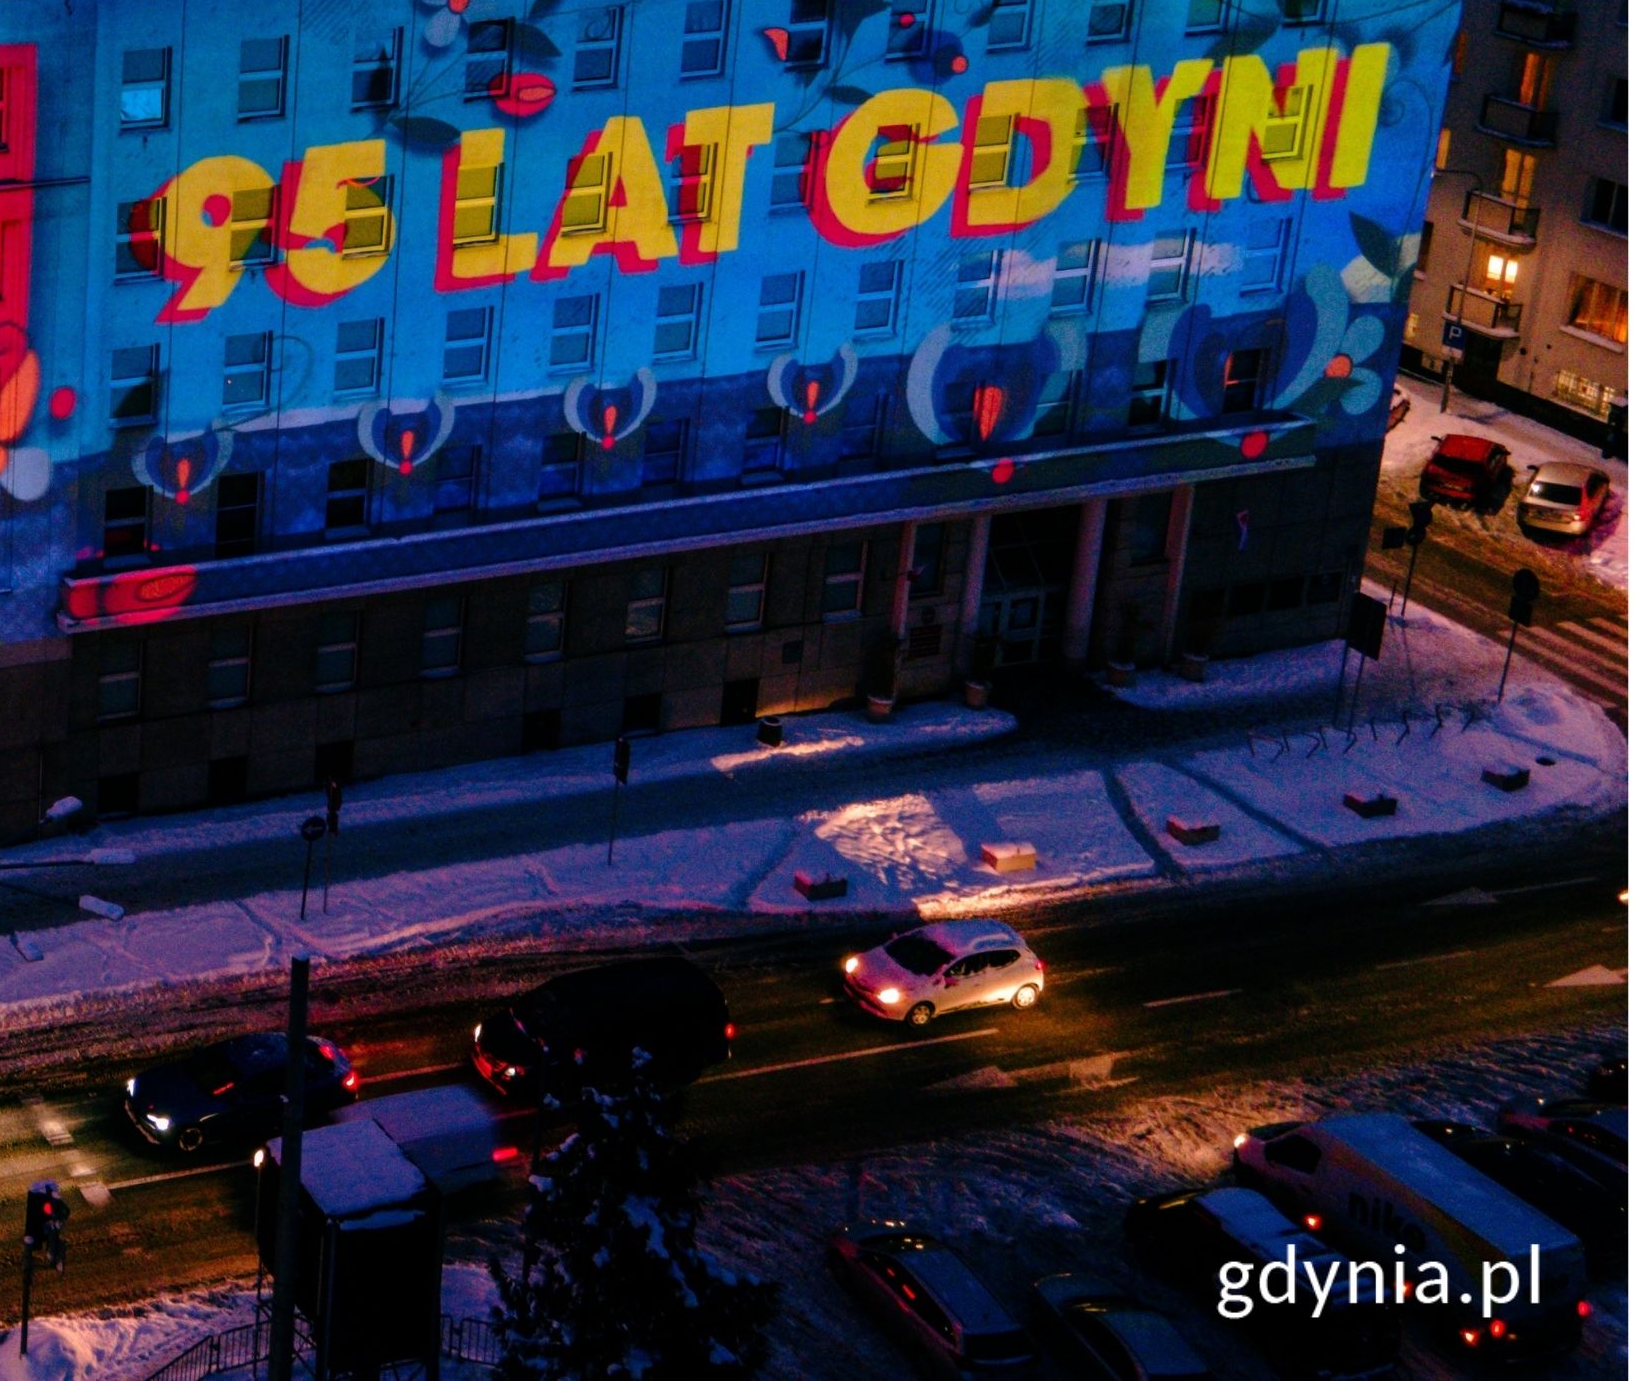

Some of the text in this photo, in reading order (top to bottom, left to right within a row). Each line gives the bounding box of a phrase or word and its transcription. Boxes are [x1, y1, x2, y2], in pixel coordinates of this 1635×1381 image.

[153, 42, 1391, 315] 95 LAT GDYNI
[1449, 325, 1463, 340] P
